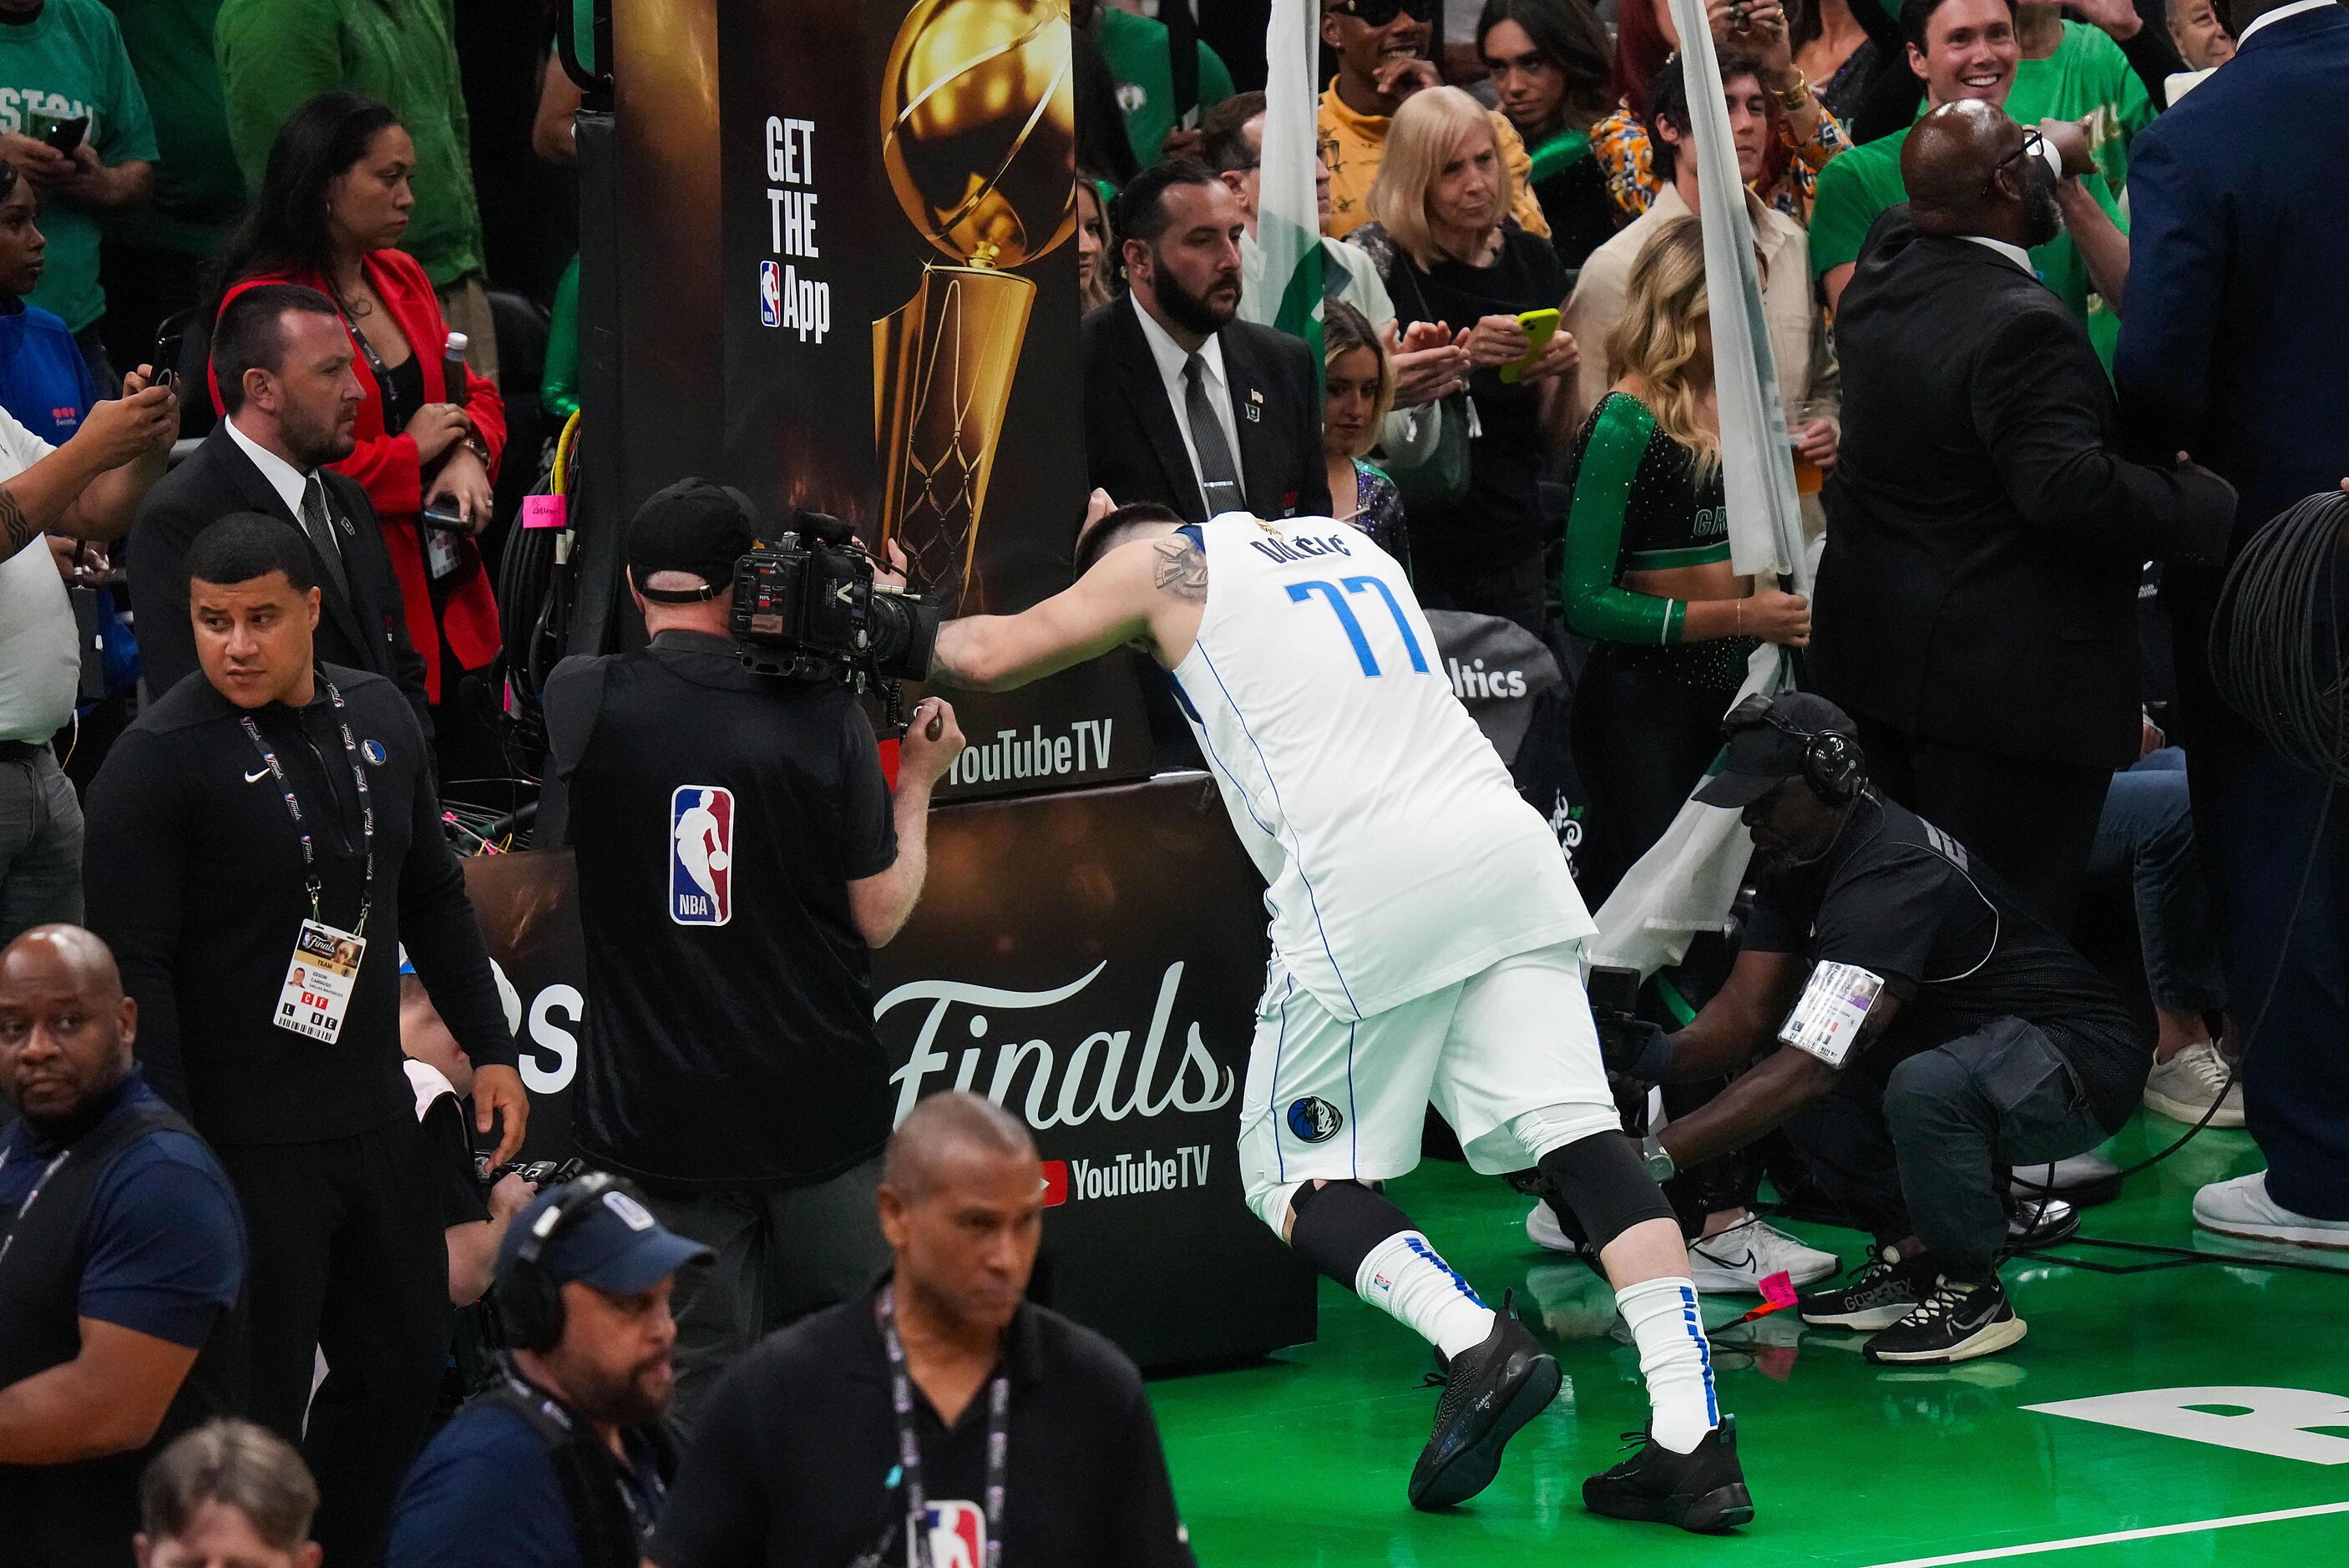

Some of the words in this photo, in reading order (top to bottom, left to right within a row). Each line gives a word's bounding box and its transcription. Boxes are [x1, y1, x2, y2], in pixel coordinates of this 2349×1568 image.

[766, 116, 815, 185] GET
[767, 188, 819, 258] THE
[764, 311, 774, 323] NBA
[783, 265, 830, 344] App
[1283, 575, 1432, 678] 77
[679, 894, 708, 915] NBA
[317, 959, 333, 969] TEAM
[873, 959, 1235, 1134] Finals
[1071, 1145, 1211, 1201] YouTubeTV
